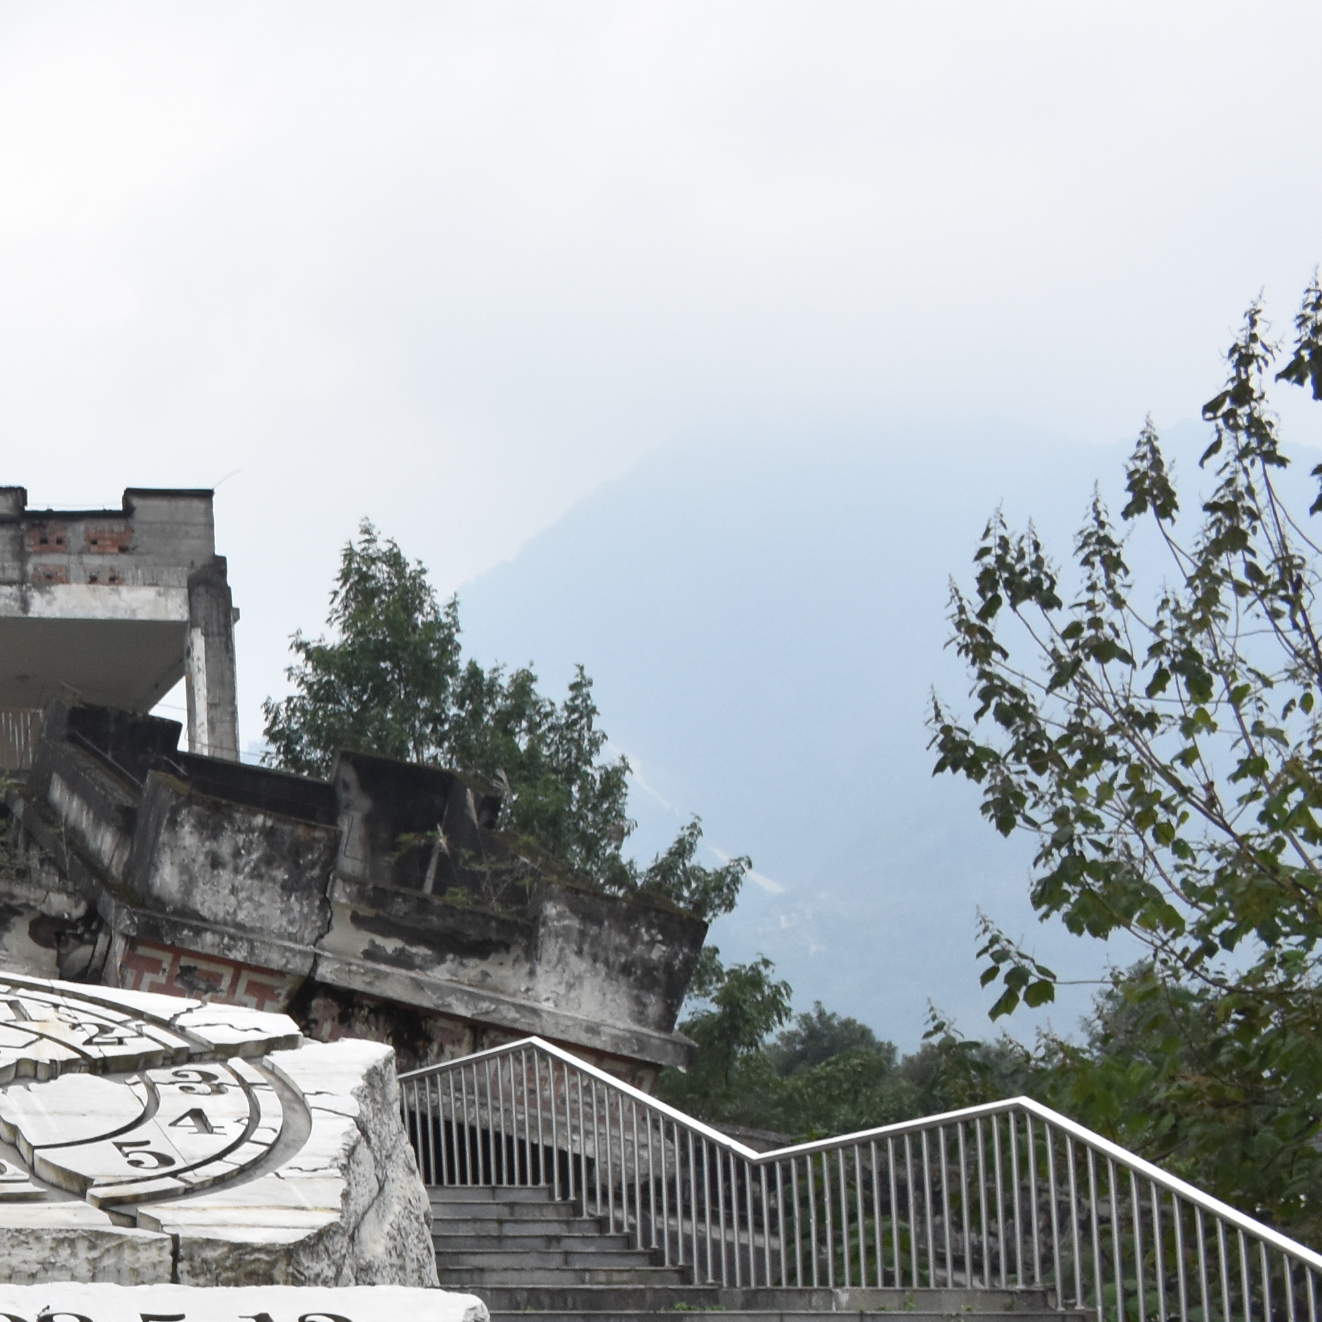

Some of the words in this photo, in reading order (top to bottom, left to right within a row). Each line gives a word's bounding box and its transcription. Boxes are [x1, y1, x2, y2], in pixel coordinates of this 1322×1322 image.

[69, 1022, 128, 1046] 2
[171, 1069, 229, 1096] 3
[168, 1107, 228, 1135] 4
[111, 1140, 176, 1169] 5
